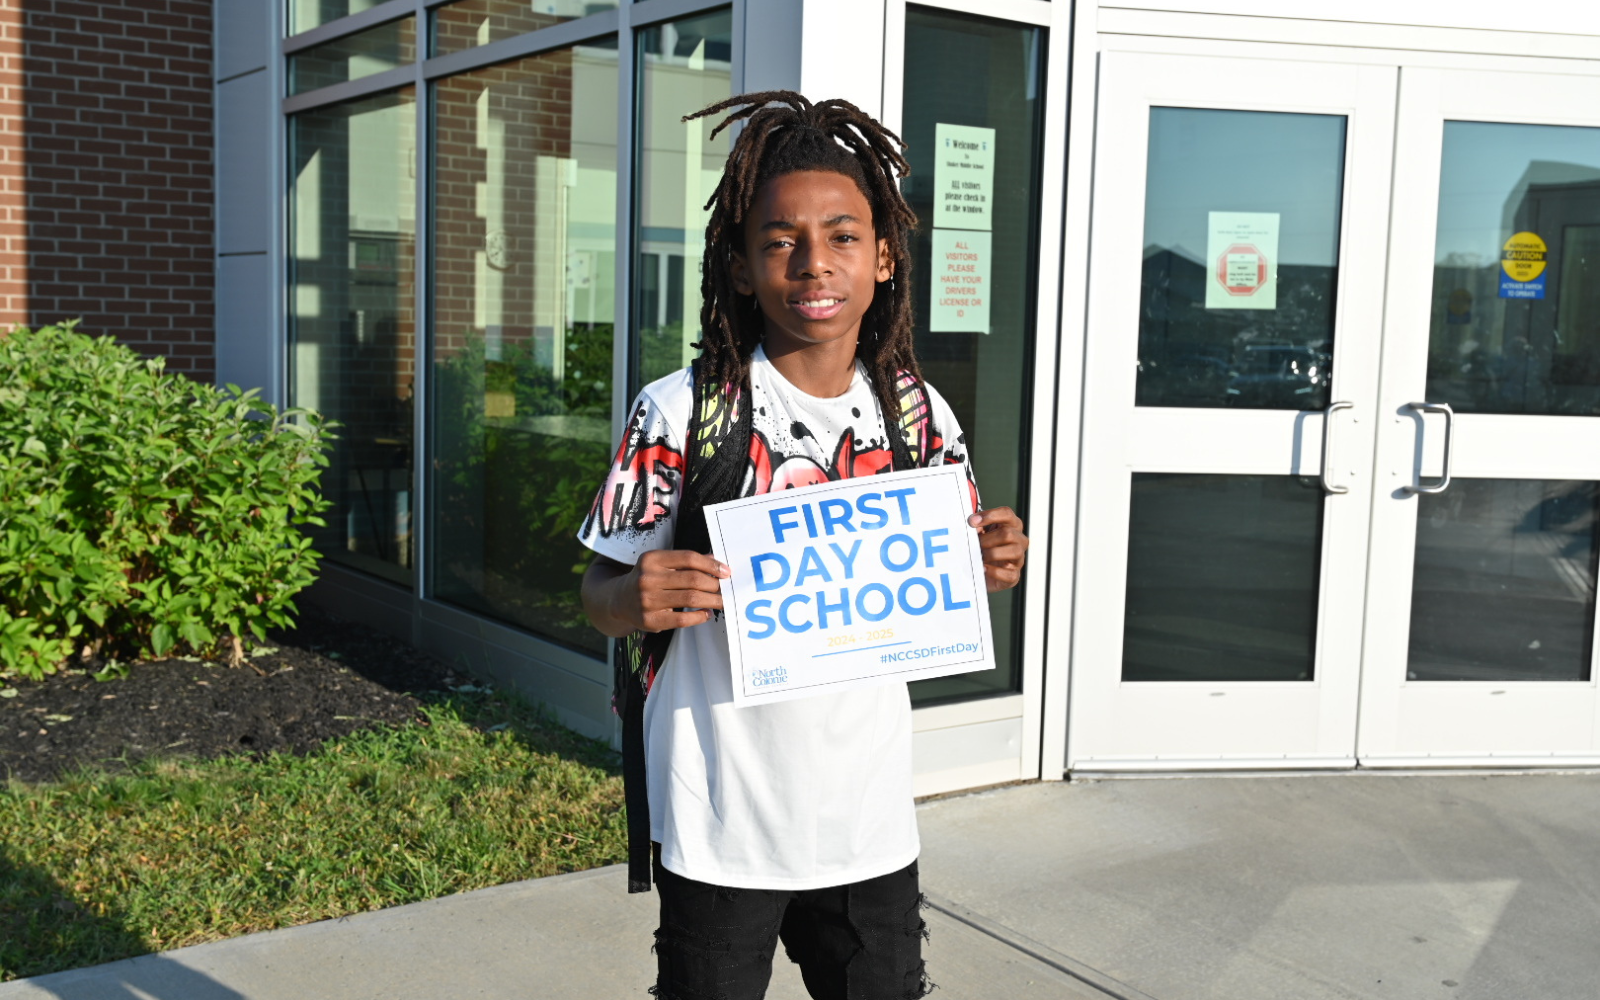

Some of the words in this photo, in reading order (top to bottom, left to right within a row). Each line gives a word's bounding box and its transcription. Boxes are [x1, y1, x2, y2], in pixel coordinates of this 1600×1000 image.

[952, 140, 979, 151] Welcome
[962, 181, 981, 190] visitors
[945, 192, 962, 202] please
[964, 193, 979, 202] check
[980, 194, 986, 202] in
[945, 204, 951, 212] at
[952, 204, 960, 212] the
[962, 205, 985, 214] window.
[955, 241, 968, 250] ALL
[946, 252, 978, 261] VISITORS
[1506, 250, 1543, 260] CAUTION
[947, 264, 976, 272] PLEASE
[940, 275, 960, 283] HAVE
[962, 276, 982, 284] YOUR
[945, 286, 976, 295] DRIVERS
[1515, 290, 1536, 298] OPERATE
[939, 298, 969, 306] LICENSE
[971, 298, 982, 306] OR
[956, 309, 964, 318] ID
[768, 487, 917, 544] FIRST
[750, 539, 863, 593] DAY
[879, 527, 950, 573] OF
[744, 573, 971, 640] SCHOOL
[826, 634, 857, 648] 2024
[866, 628, 895, 642] 2025
[880, 642, 979, 664] #NCCSDFirstDay
[758, 665, 787, 679] North
[752, 675, 788, 687] Colonie
